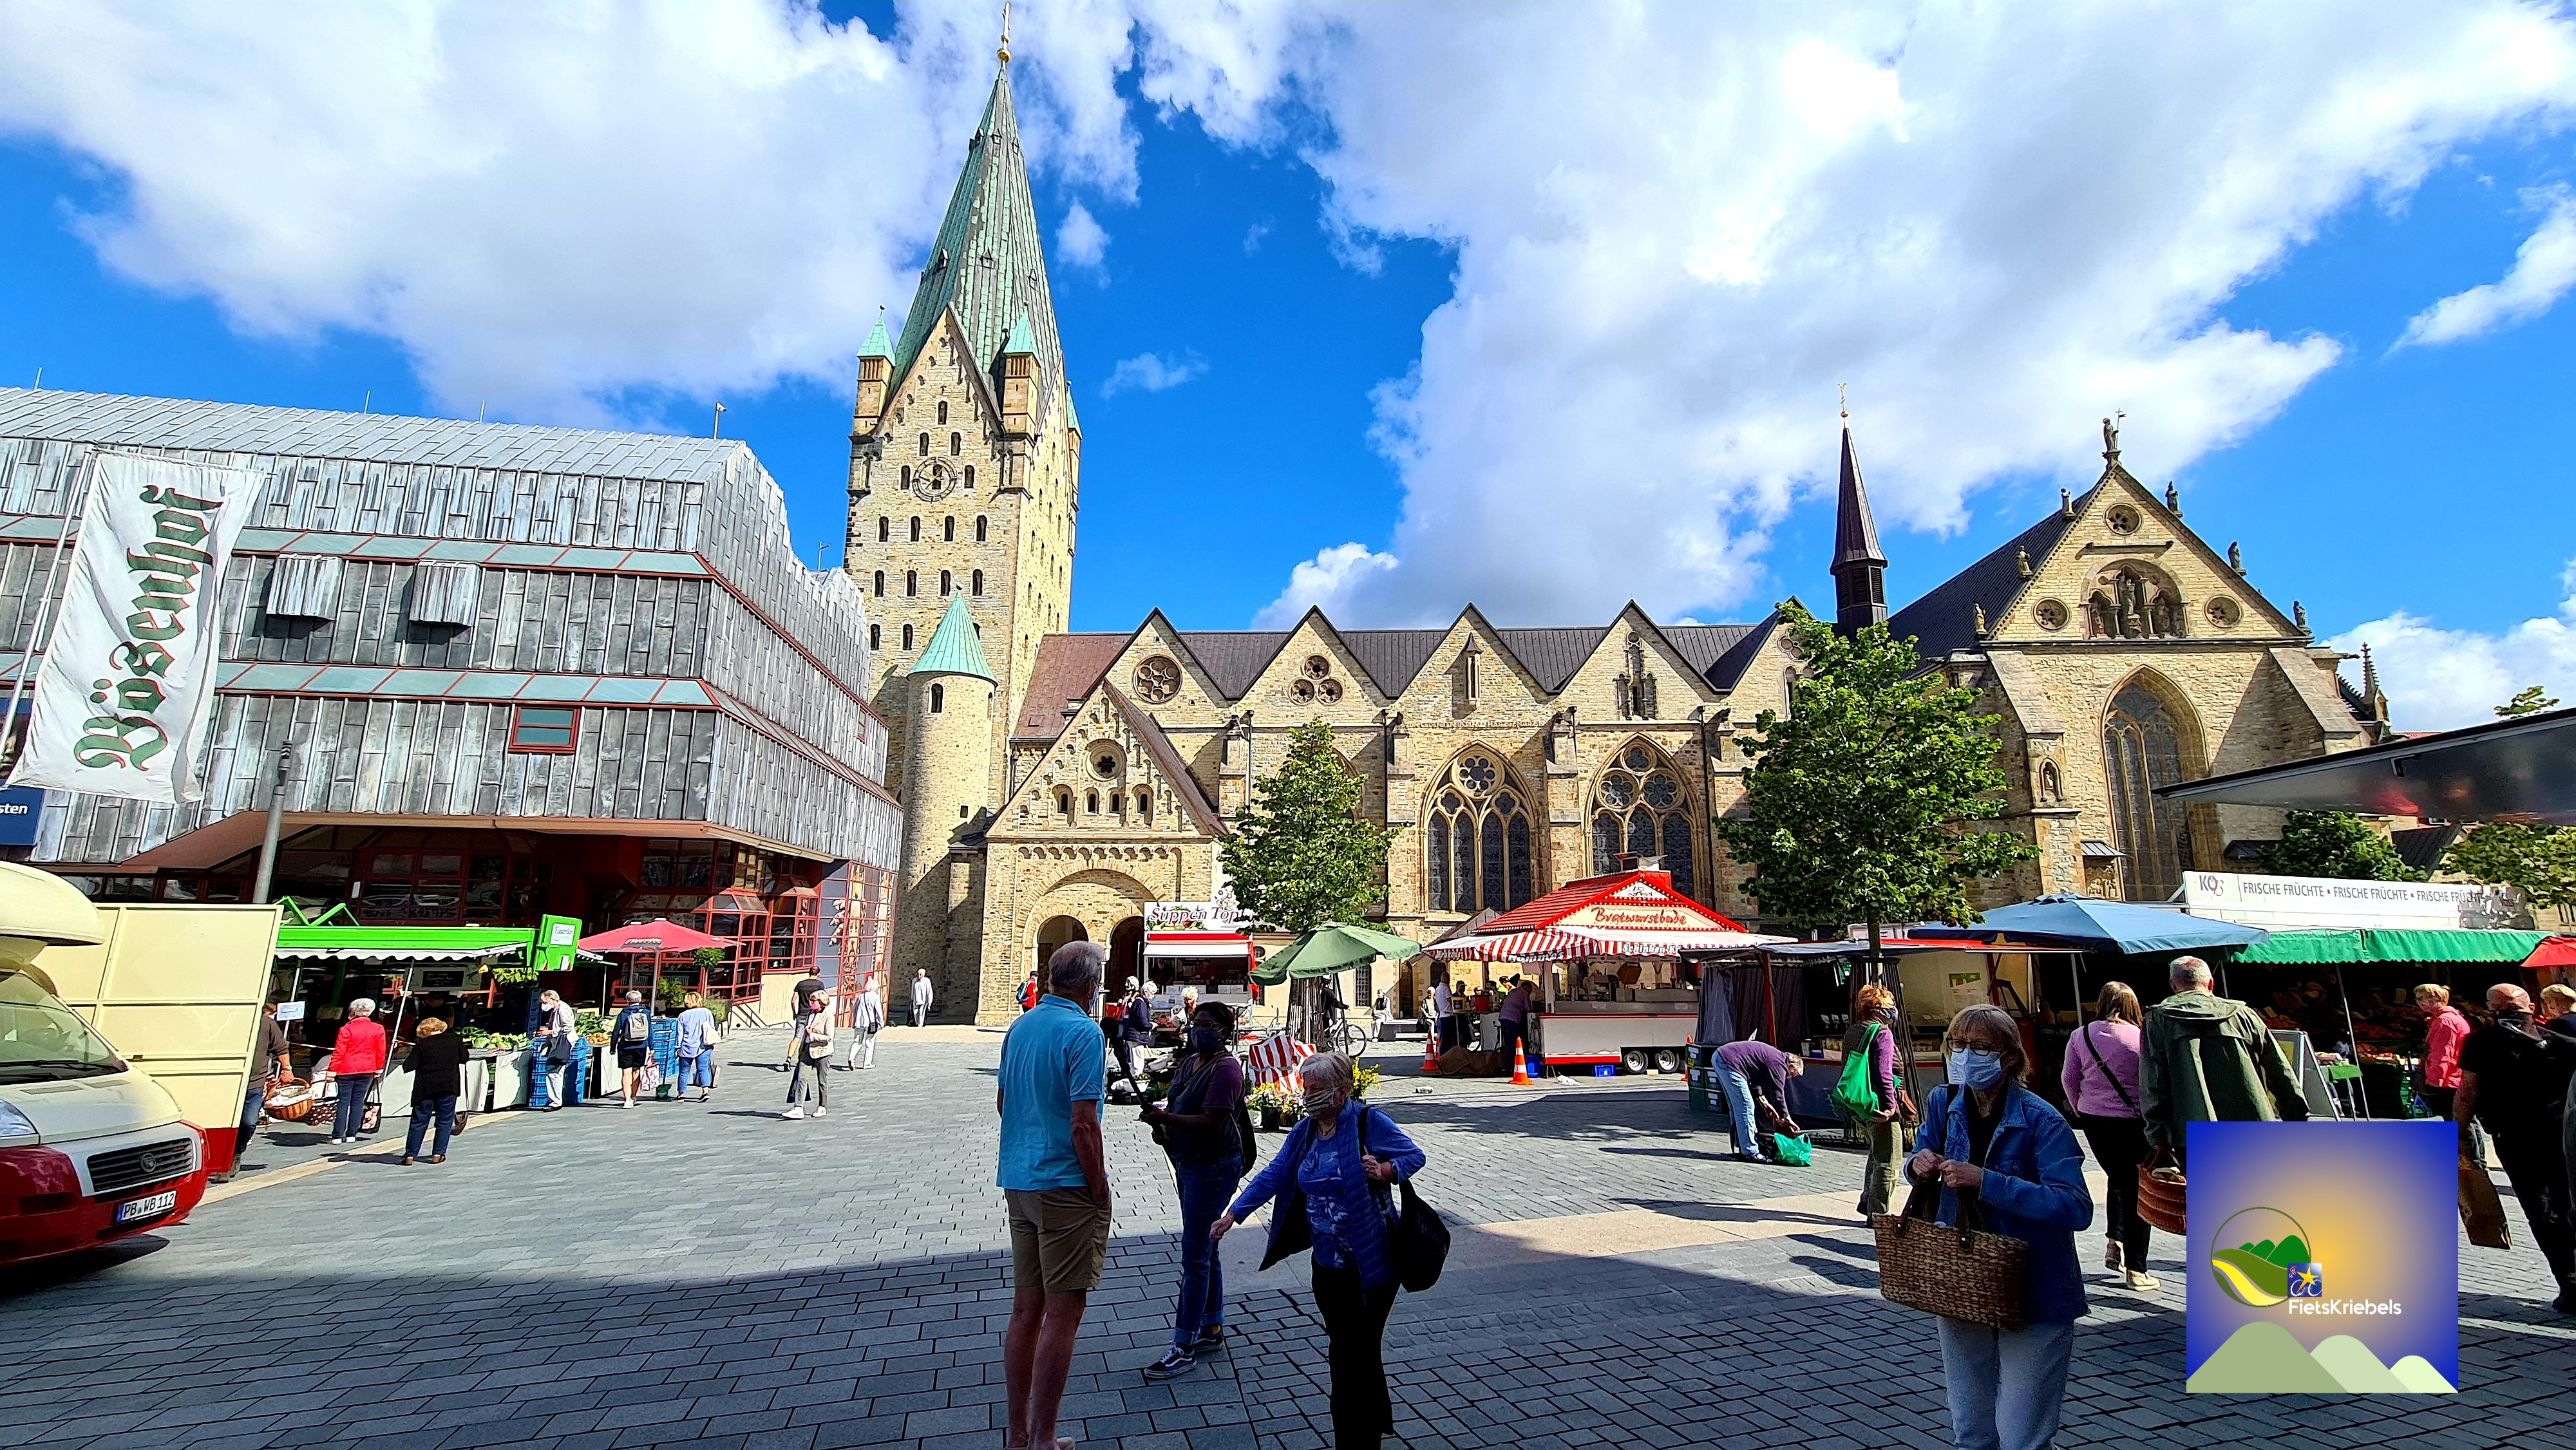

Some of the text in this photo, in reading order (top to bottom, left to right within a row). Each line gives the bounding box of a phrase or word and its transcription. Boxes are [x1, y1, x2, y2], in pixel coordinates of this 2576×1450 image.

[2243, 881, 2282, 895] FRISCHE
[2284, 882, 2325, 897] FRÜCHTE
[2333, 886, 2369, 899] FRISCHE
[2371, 886, 2409, 901] FRÜCHTE
[2416, 890, 2448, 902] FRISCHE
[1151, 907, 1208, 925] Suppen
[1591, 907, 1687, 925] Bratwurstbude
[123, 1192, 175, 1218] PB WB 112
